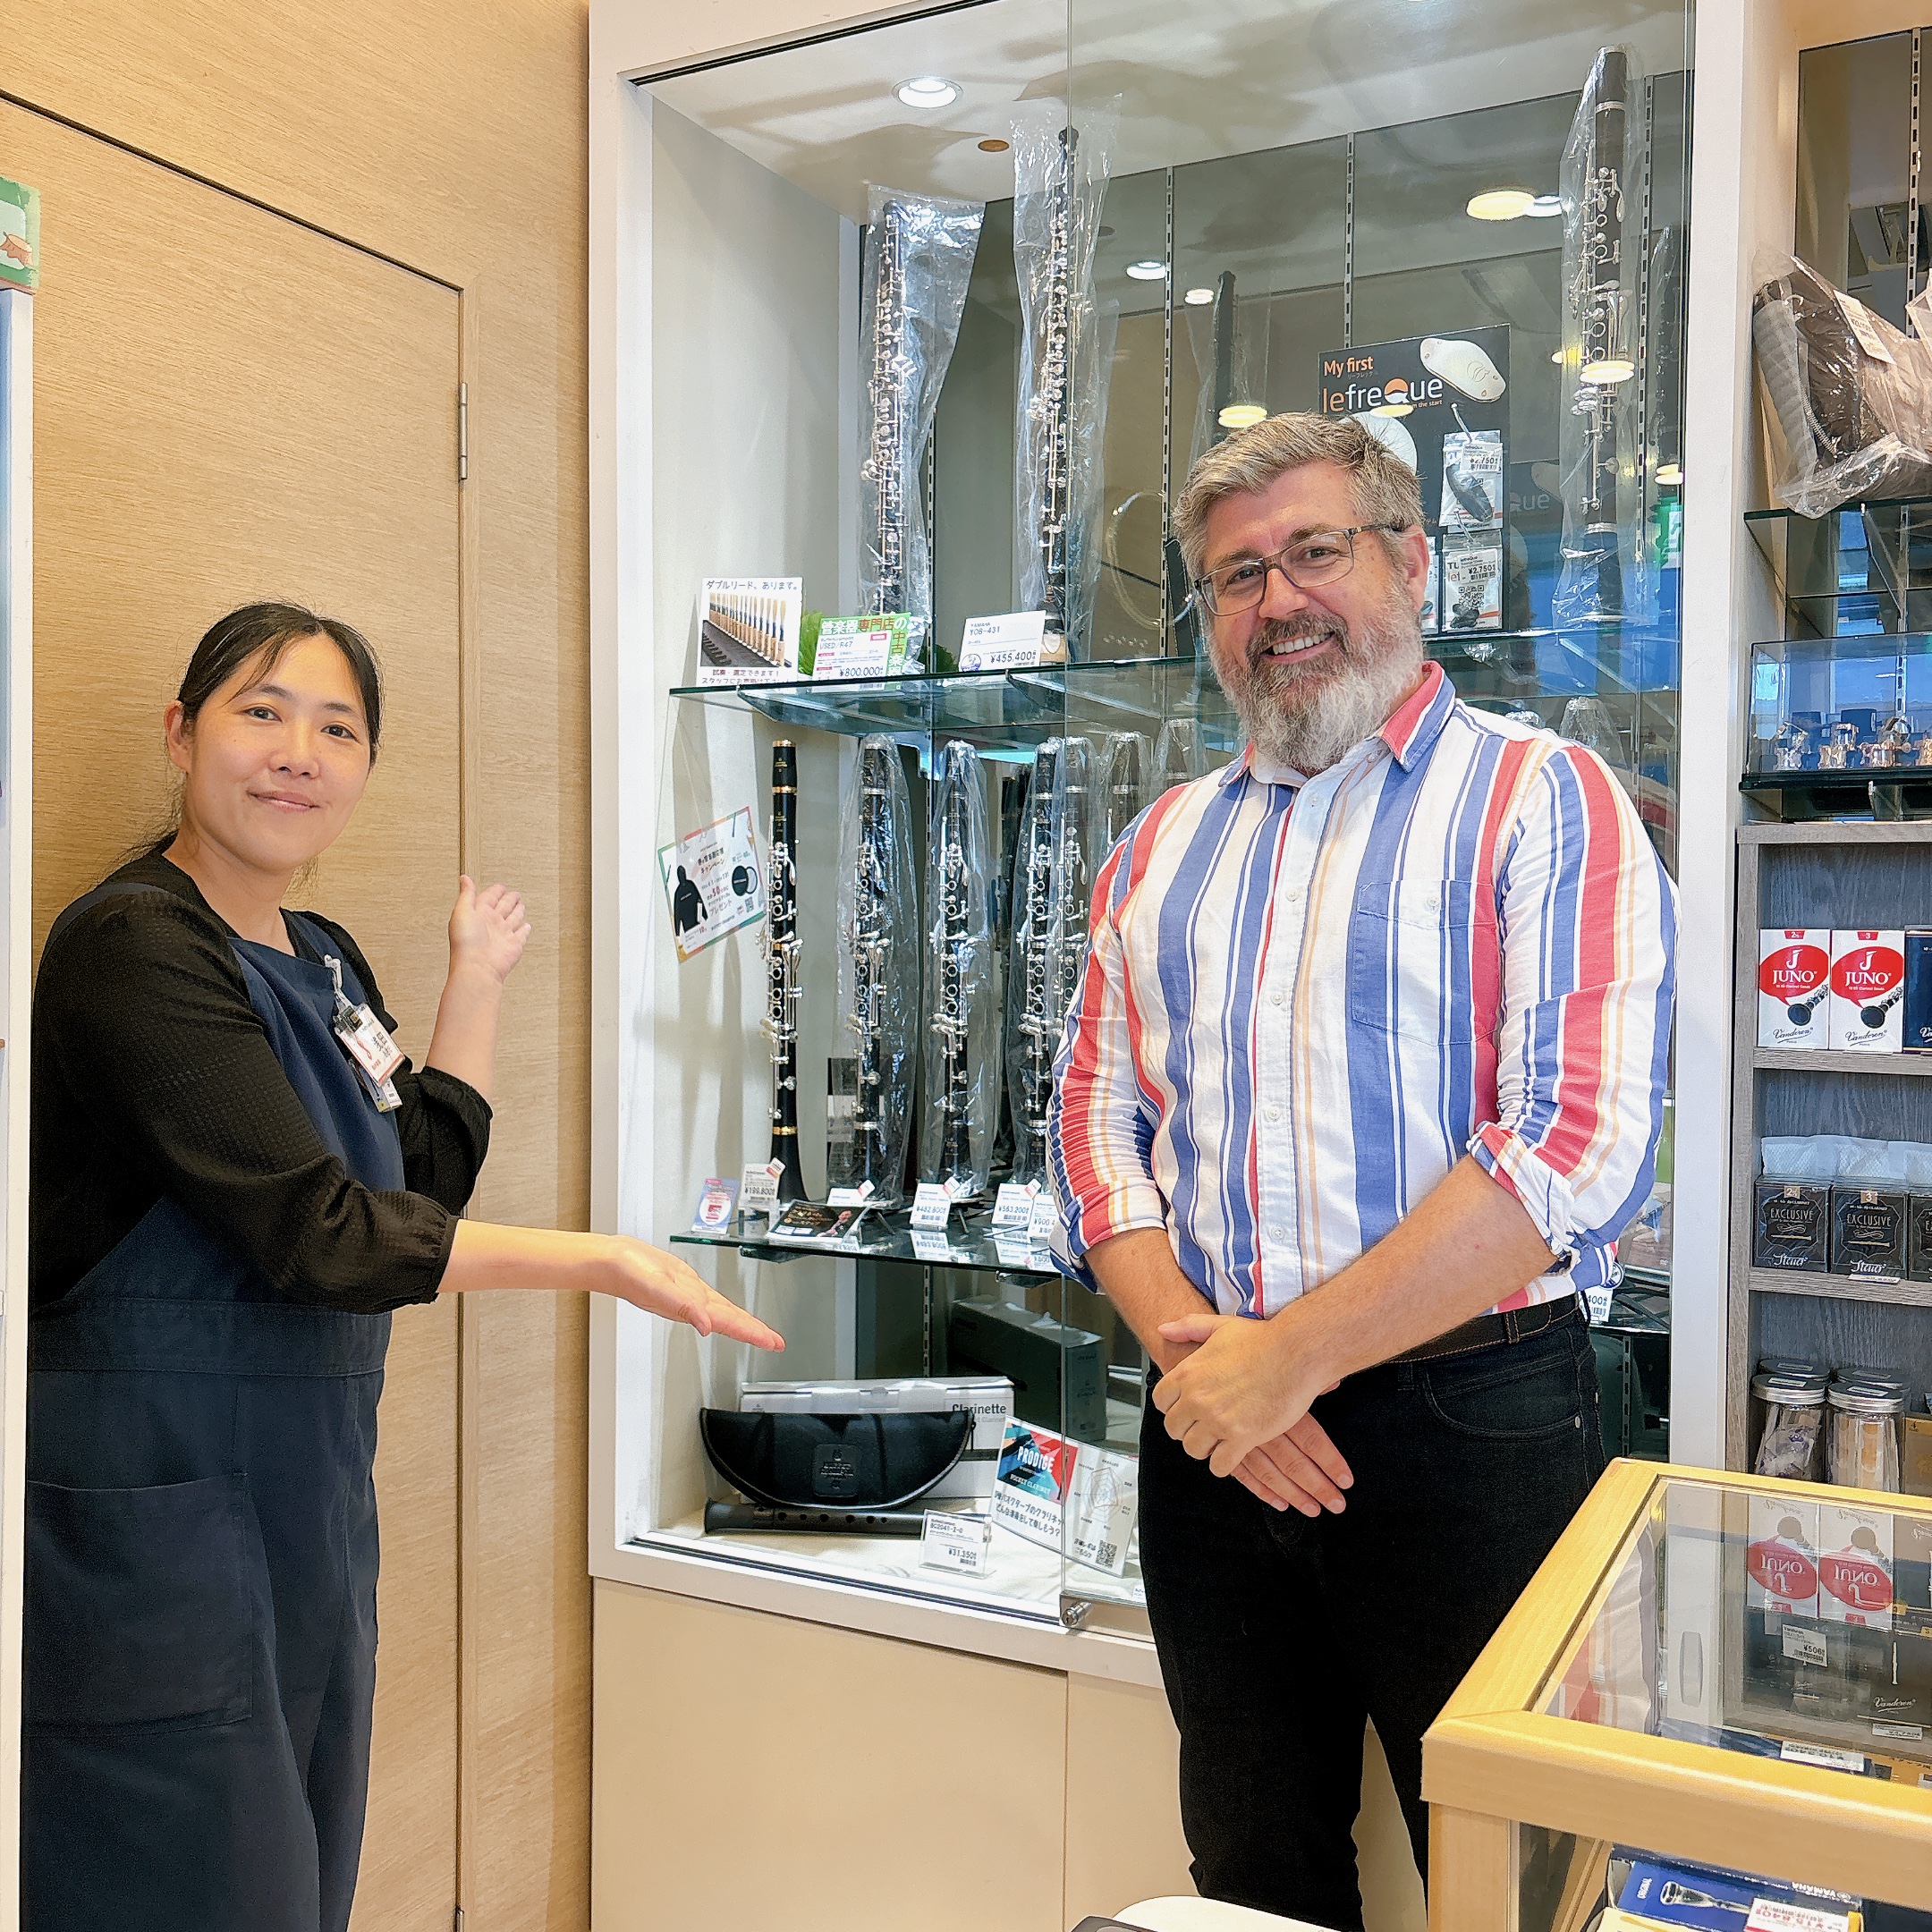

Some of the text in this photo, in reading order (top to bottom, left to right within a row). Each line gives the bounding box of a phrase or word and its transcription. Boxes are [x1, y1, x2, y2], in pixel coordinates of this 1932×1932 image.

[1324, 355, 1374, 378] My first
[1323, 377, 1444, 413] lefreQue
[706, 580, 798, 590] ダブルリード、あります。
[821, 616, 908, 635] 管楽器専門店の
[1773, 970, 1815, 985] JUNO
[1845, 971, 1889, 987] JUNO
[1771, 1208, 1814, 1221] EXCLUSIVE
[1847, 1213, 1892, 1227] EXCLUSIVE
[1016, 1445, 1055, 1473] PRODIGE
[1803, 1644, 1823, 1656] ¥506
